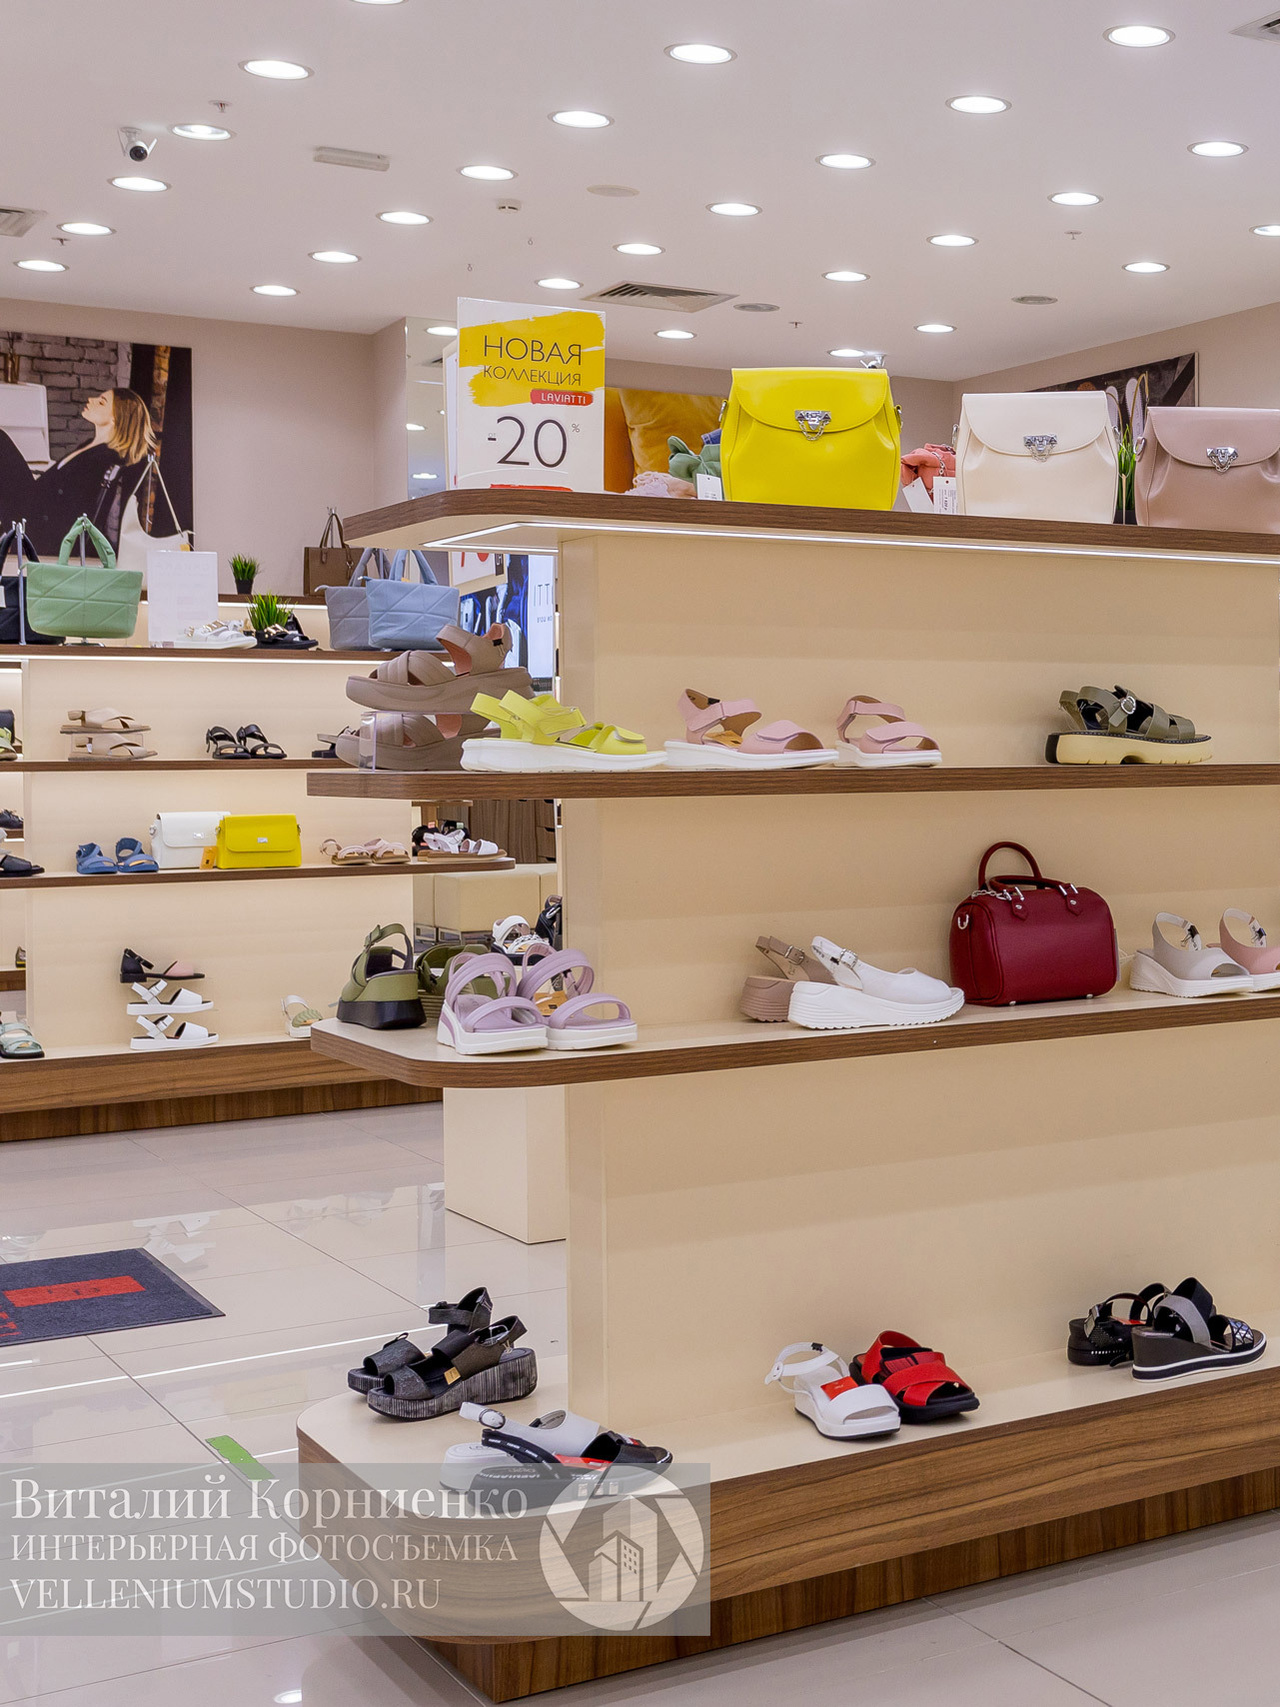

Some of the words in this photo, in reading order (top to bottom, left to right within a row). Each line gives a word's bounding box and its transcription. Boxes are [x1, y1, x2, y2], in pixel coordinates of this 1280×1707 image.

[483, 335, 582, 366] НОВАЯ
[483, 365, 582, 387] КОЛЛЕКЦИЯ
[541, 392, 587, 405] LAVIATTI
